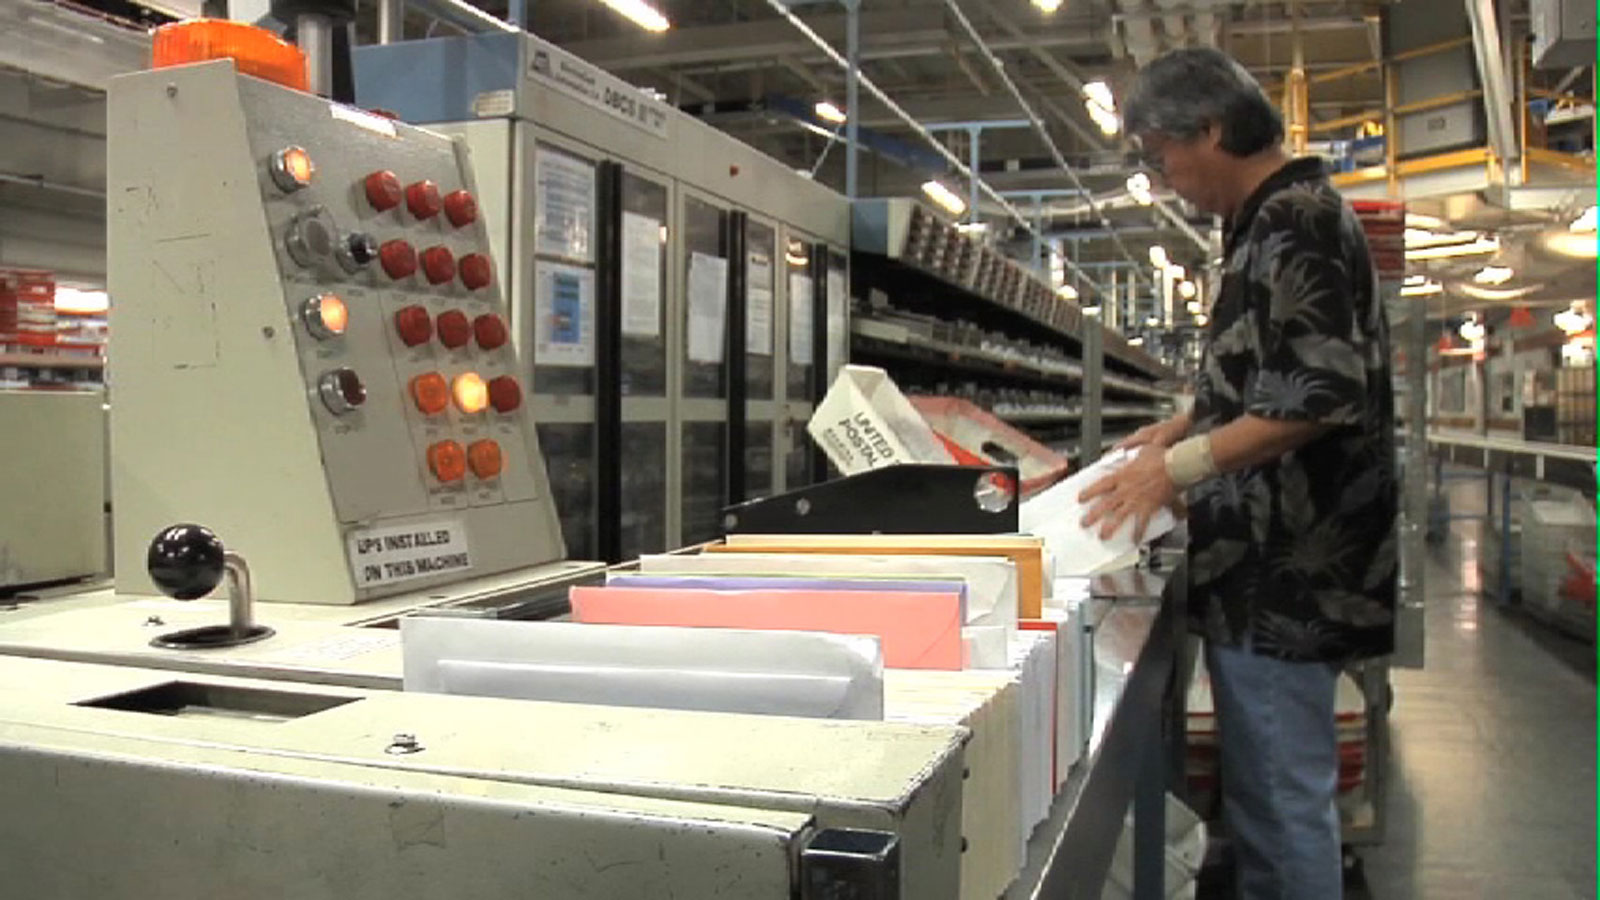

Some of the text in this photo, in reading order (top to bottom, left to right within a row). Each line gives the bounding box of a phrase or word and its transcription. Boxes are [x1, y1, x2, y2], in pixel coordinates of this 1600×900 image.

[838, 417, 878, 467] POSTAL
[854, 411, 895, 458] UNITED
[357, 530, 451, 554] UPS INSTALLED
[365, 552, 469, 581] ON THIS MACHINE
